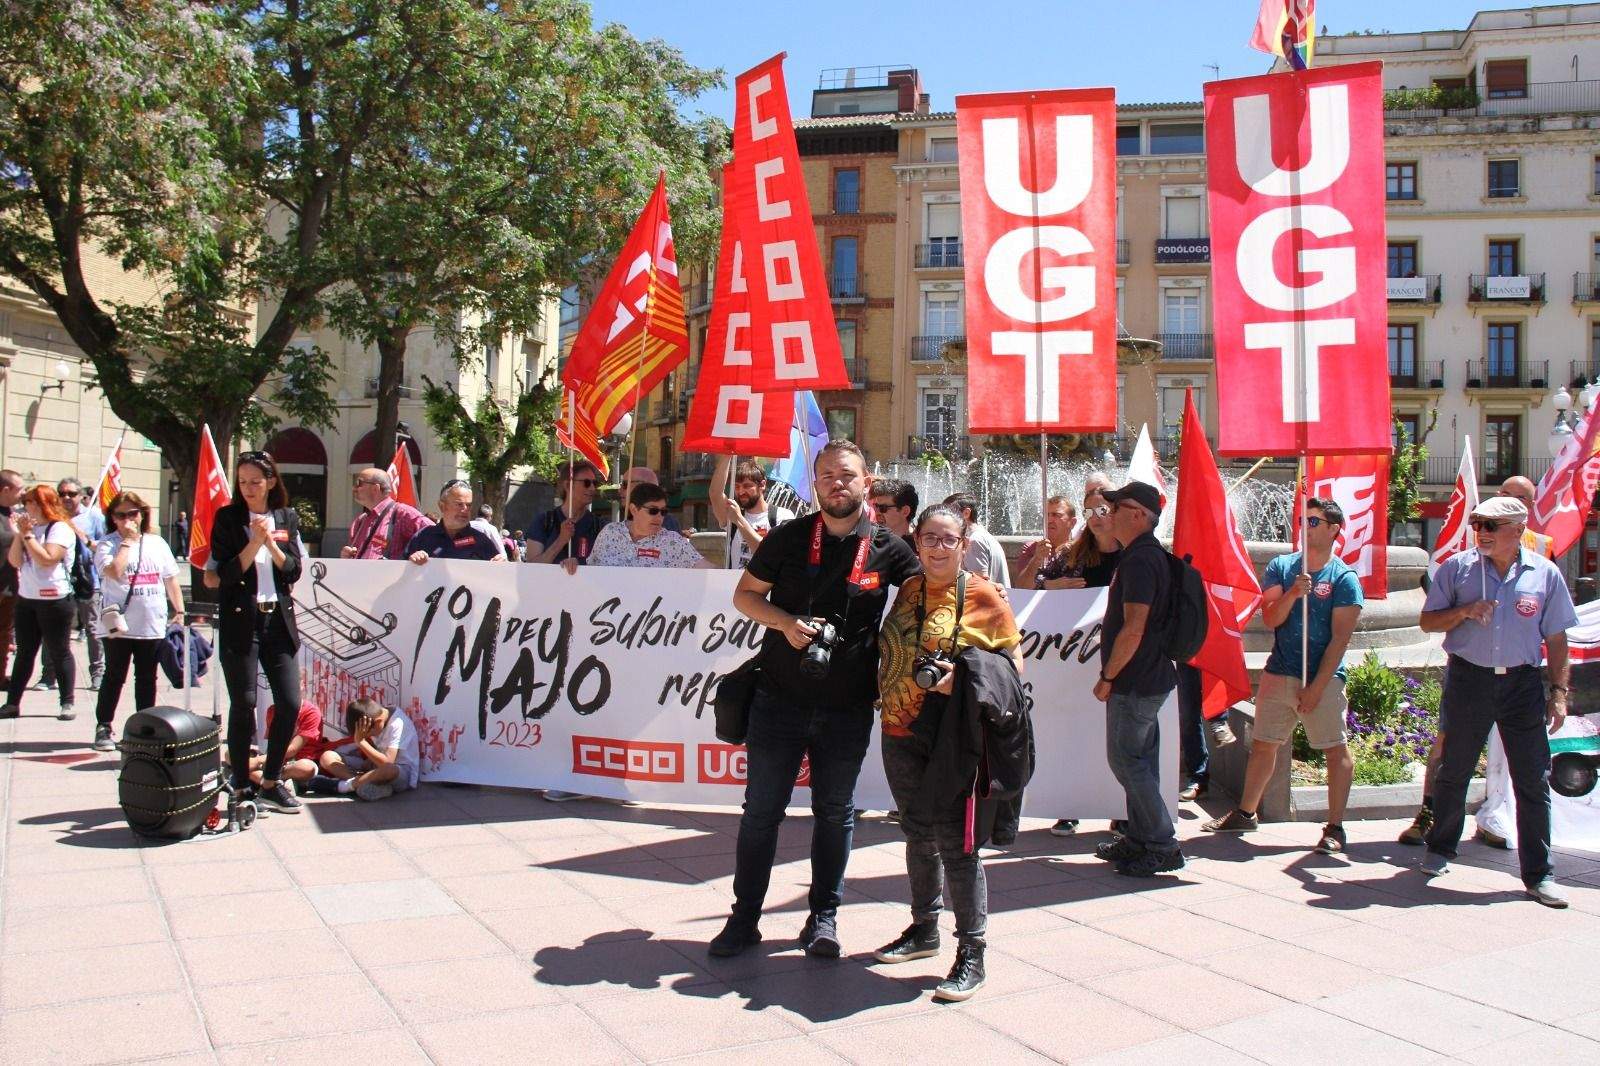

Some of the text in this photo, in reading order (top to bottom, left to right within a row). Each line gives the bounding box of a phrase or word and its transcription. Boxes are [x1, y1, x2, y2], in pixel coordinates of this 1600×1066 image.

[748, 73, 819, 380] CCOO
[1157, 244, 1209, 254] PODÓLOGO
[1232, 83, 1357, 423] UGT
[981, 114, 1097, 423] UGT
[812, 522, 822, 549] Canon
[854, 540, 867, 569] Canon
[502, 616, 539, 646] DE
[589, 595, 697, 649] Subir
[434, 596, 612, 740] MAYO
[657, 671, 723, 720] rep
[488, 720, 542, 749] 2023
[579, 743, 676, 774] CCOO
[703, 749, 748, 780] UG
